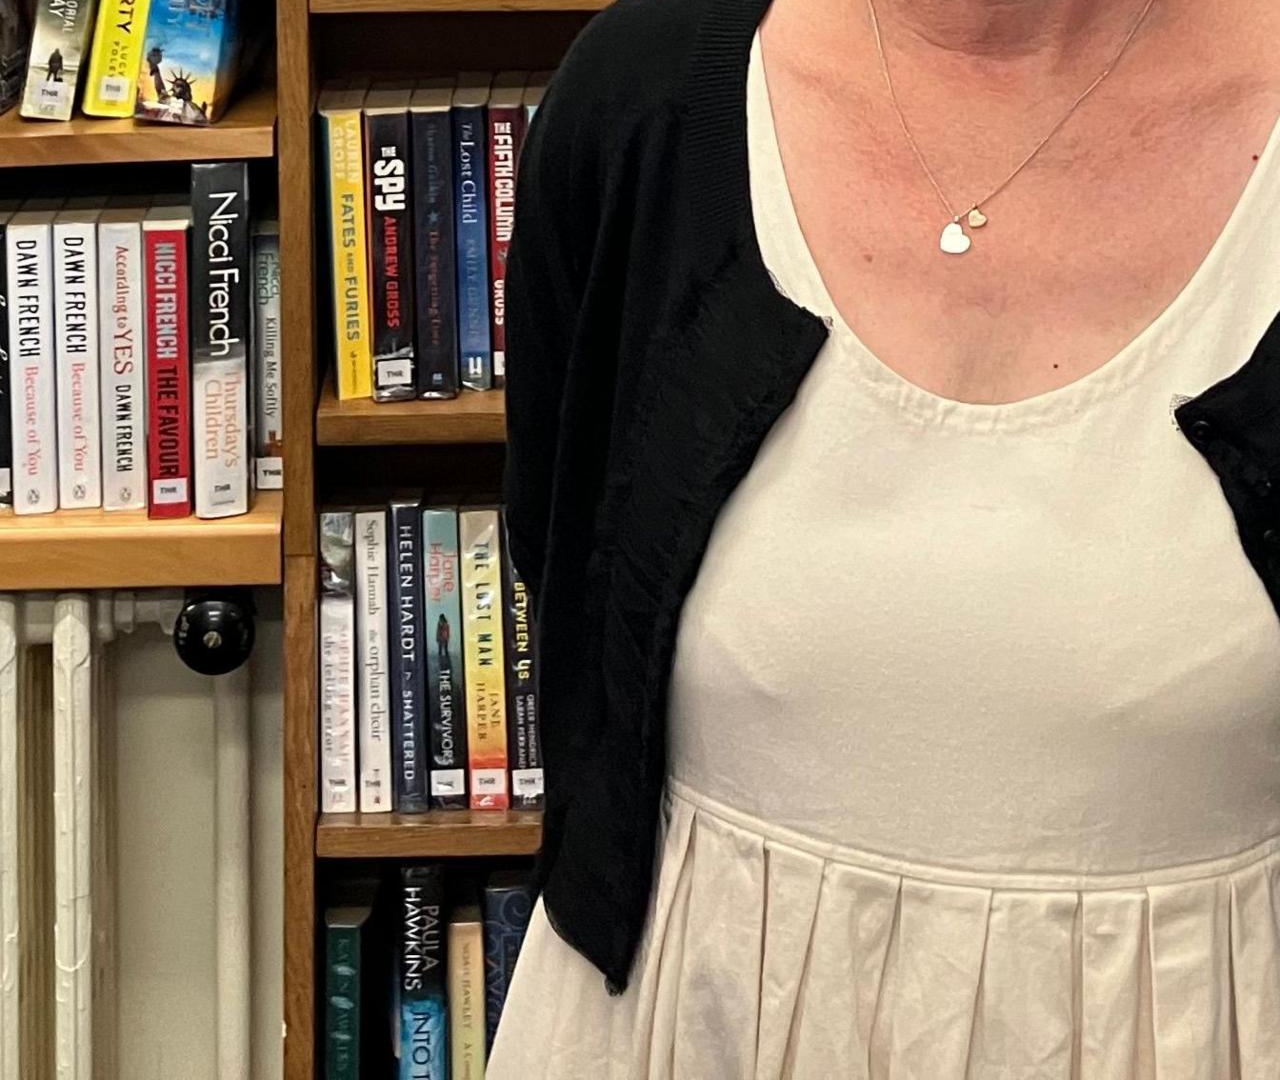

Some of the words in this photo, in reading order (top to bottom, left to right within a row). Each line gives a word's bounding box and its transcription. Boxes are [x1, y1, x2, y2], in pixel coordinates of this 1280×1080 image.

[374, 159, 405, 211] SPY
[208, 192, 239, 263] Nicci
[342, 194, 356, 248] FATES
[384, 216, 398, 276] ANDREW
[16, 240, 37, 288] DAWN
[19, 294, 40, 357] FRENCH
[209, 268, 239, 357] French
[345, 276, 359, 341] FURIES
[385, 281, 399, 328] GROSS
[399, 525, 413, 587] HELEN
[401, 596, 414, 662] HARDT
[513, 582, 528, 653] BETWEEN
[403, 888, 422, 991] HAWKINS
[420, 906, 439, 971] PAULA
